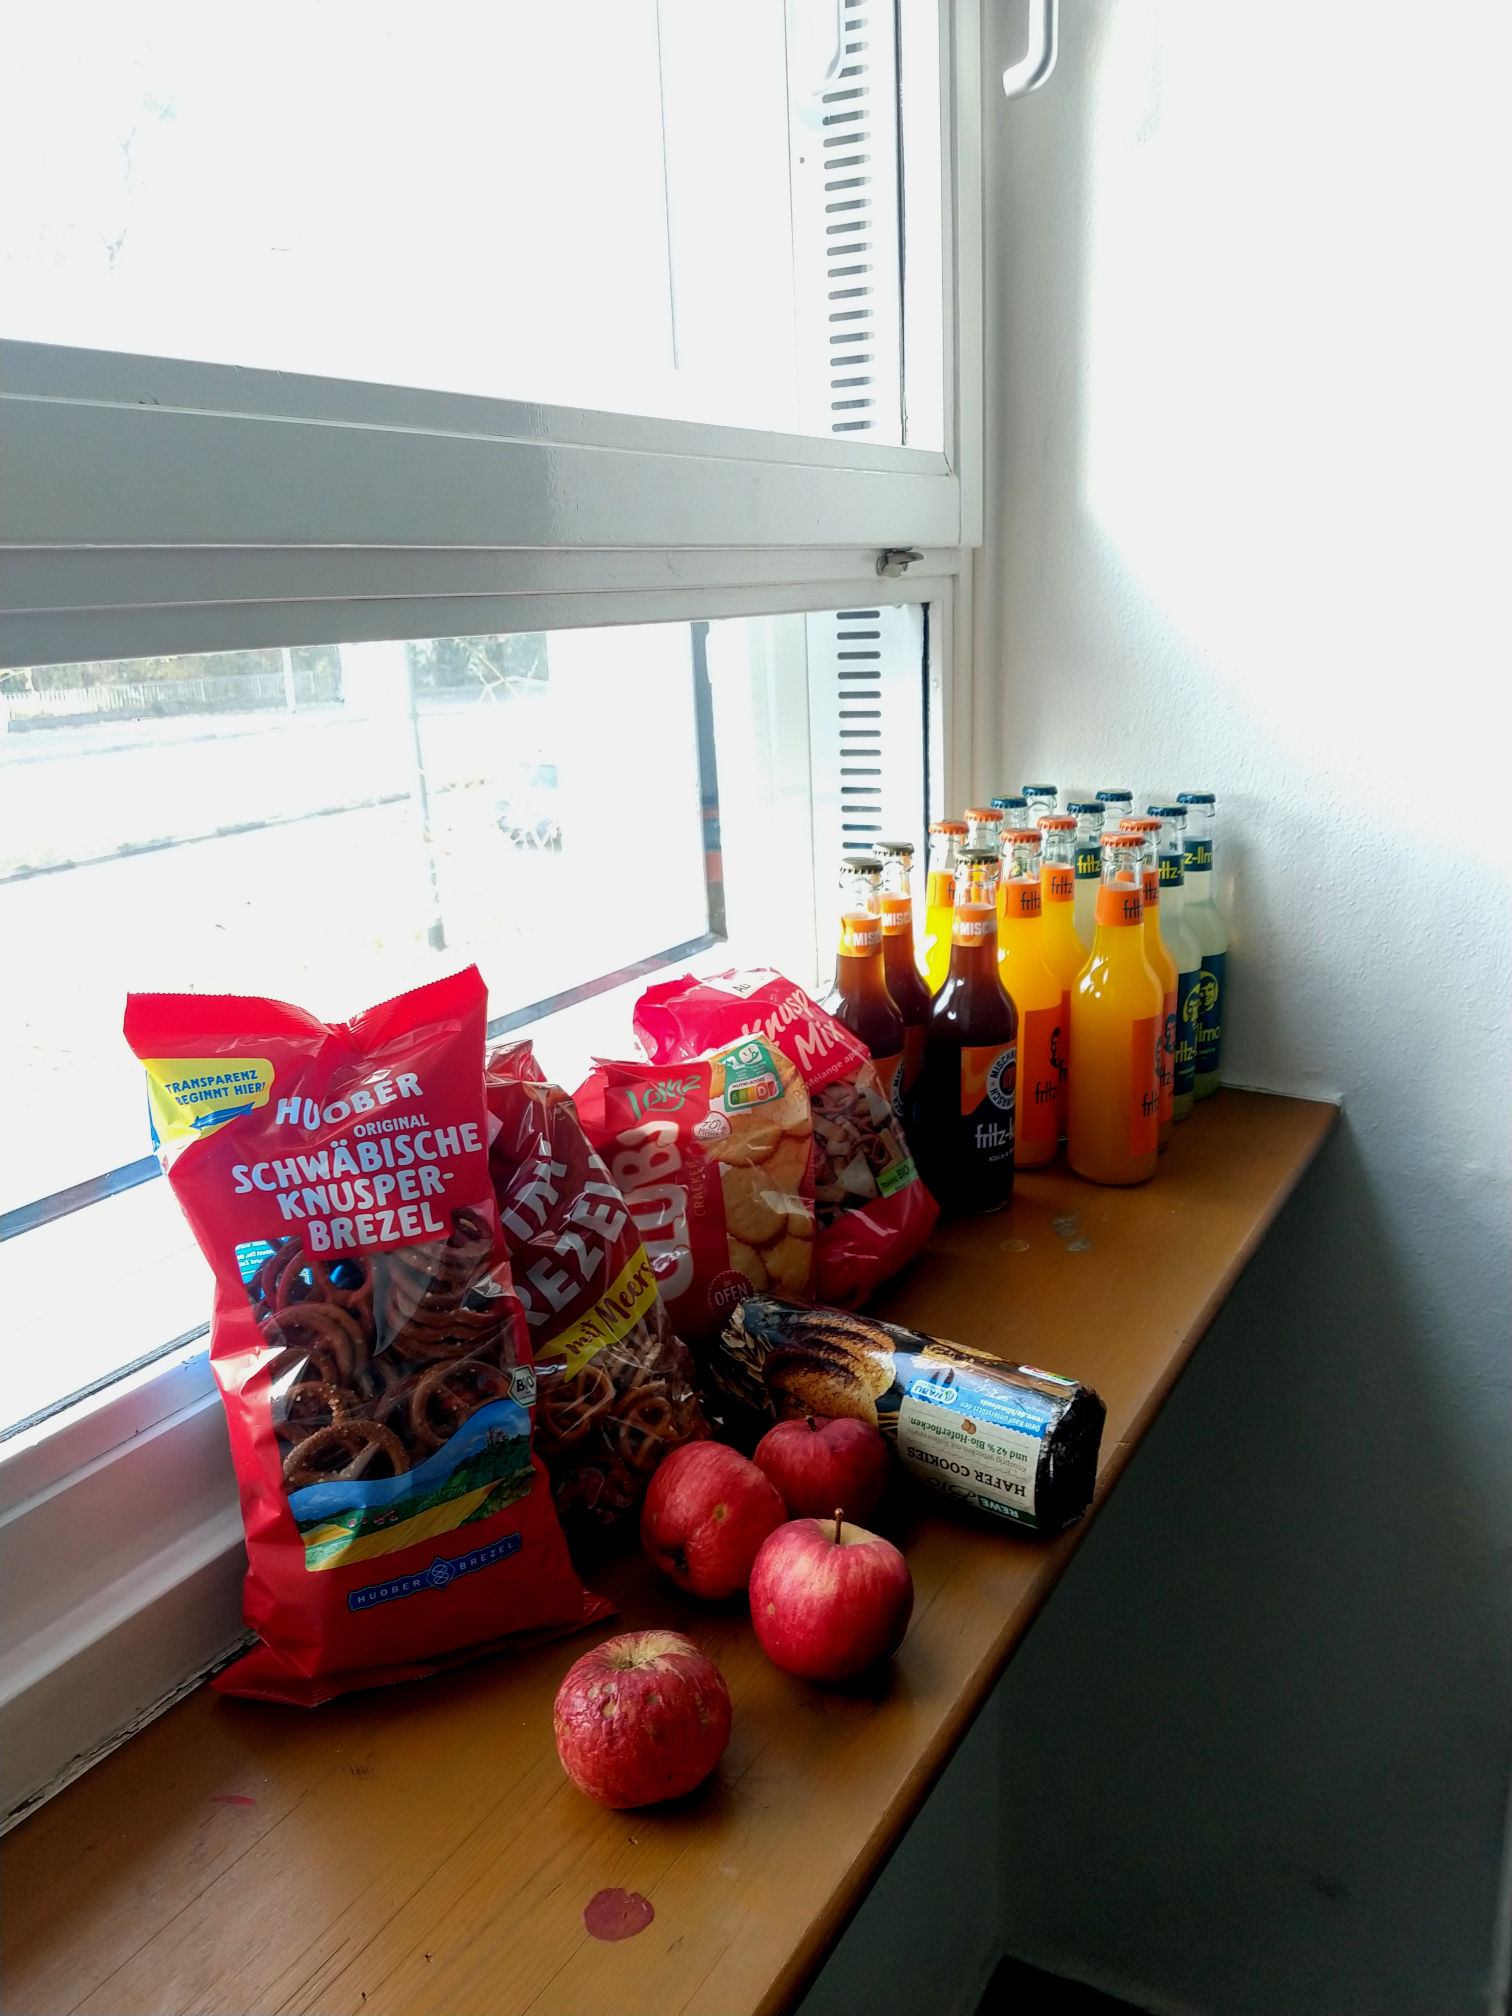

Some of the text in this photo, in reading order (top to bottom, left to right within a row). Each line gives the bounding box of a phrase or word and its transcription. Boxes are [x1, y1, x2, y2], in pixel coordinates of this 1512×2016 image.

[794, 1019, 845, 1072] Mix
[165, 1070, 258, 1095] TRANSPARENZ
[175, 1081, 267, 1107] BEGINNT HIER!
[275, 1072, 425, 1131] HUOBER
[353, 1113, 430, 1139] ORIGINAL
[231, 1122, 483, 1195] SCHWÄBISCHE
[275, 1164, 455, 1222] KNUSPER-
[308, 1202, 444, 1253] BREZEL
[714, 1281, 749, 1306] OFEN
[566, 1320, 600, 1355] mit
[914, 1385, 944, 1399] NABU
[906, 1446, 1026, 1497] HAFER COOKIES
[1008, 1449, 1029, 1464] und
[979, 1498, 1020, 1518] REWE
[358, 1543, 514, 1605] HUOBER BREZEL
